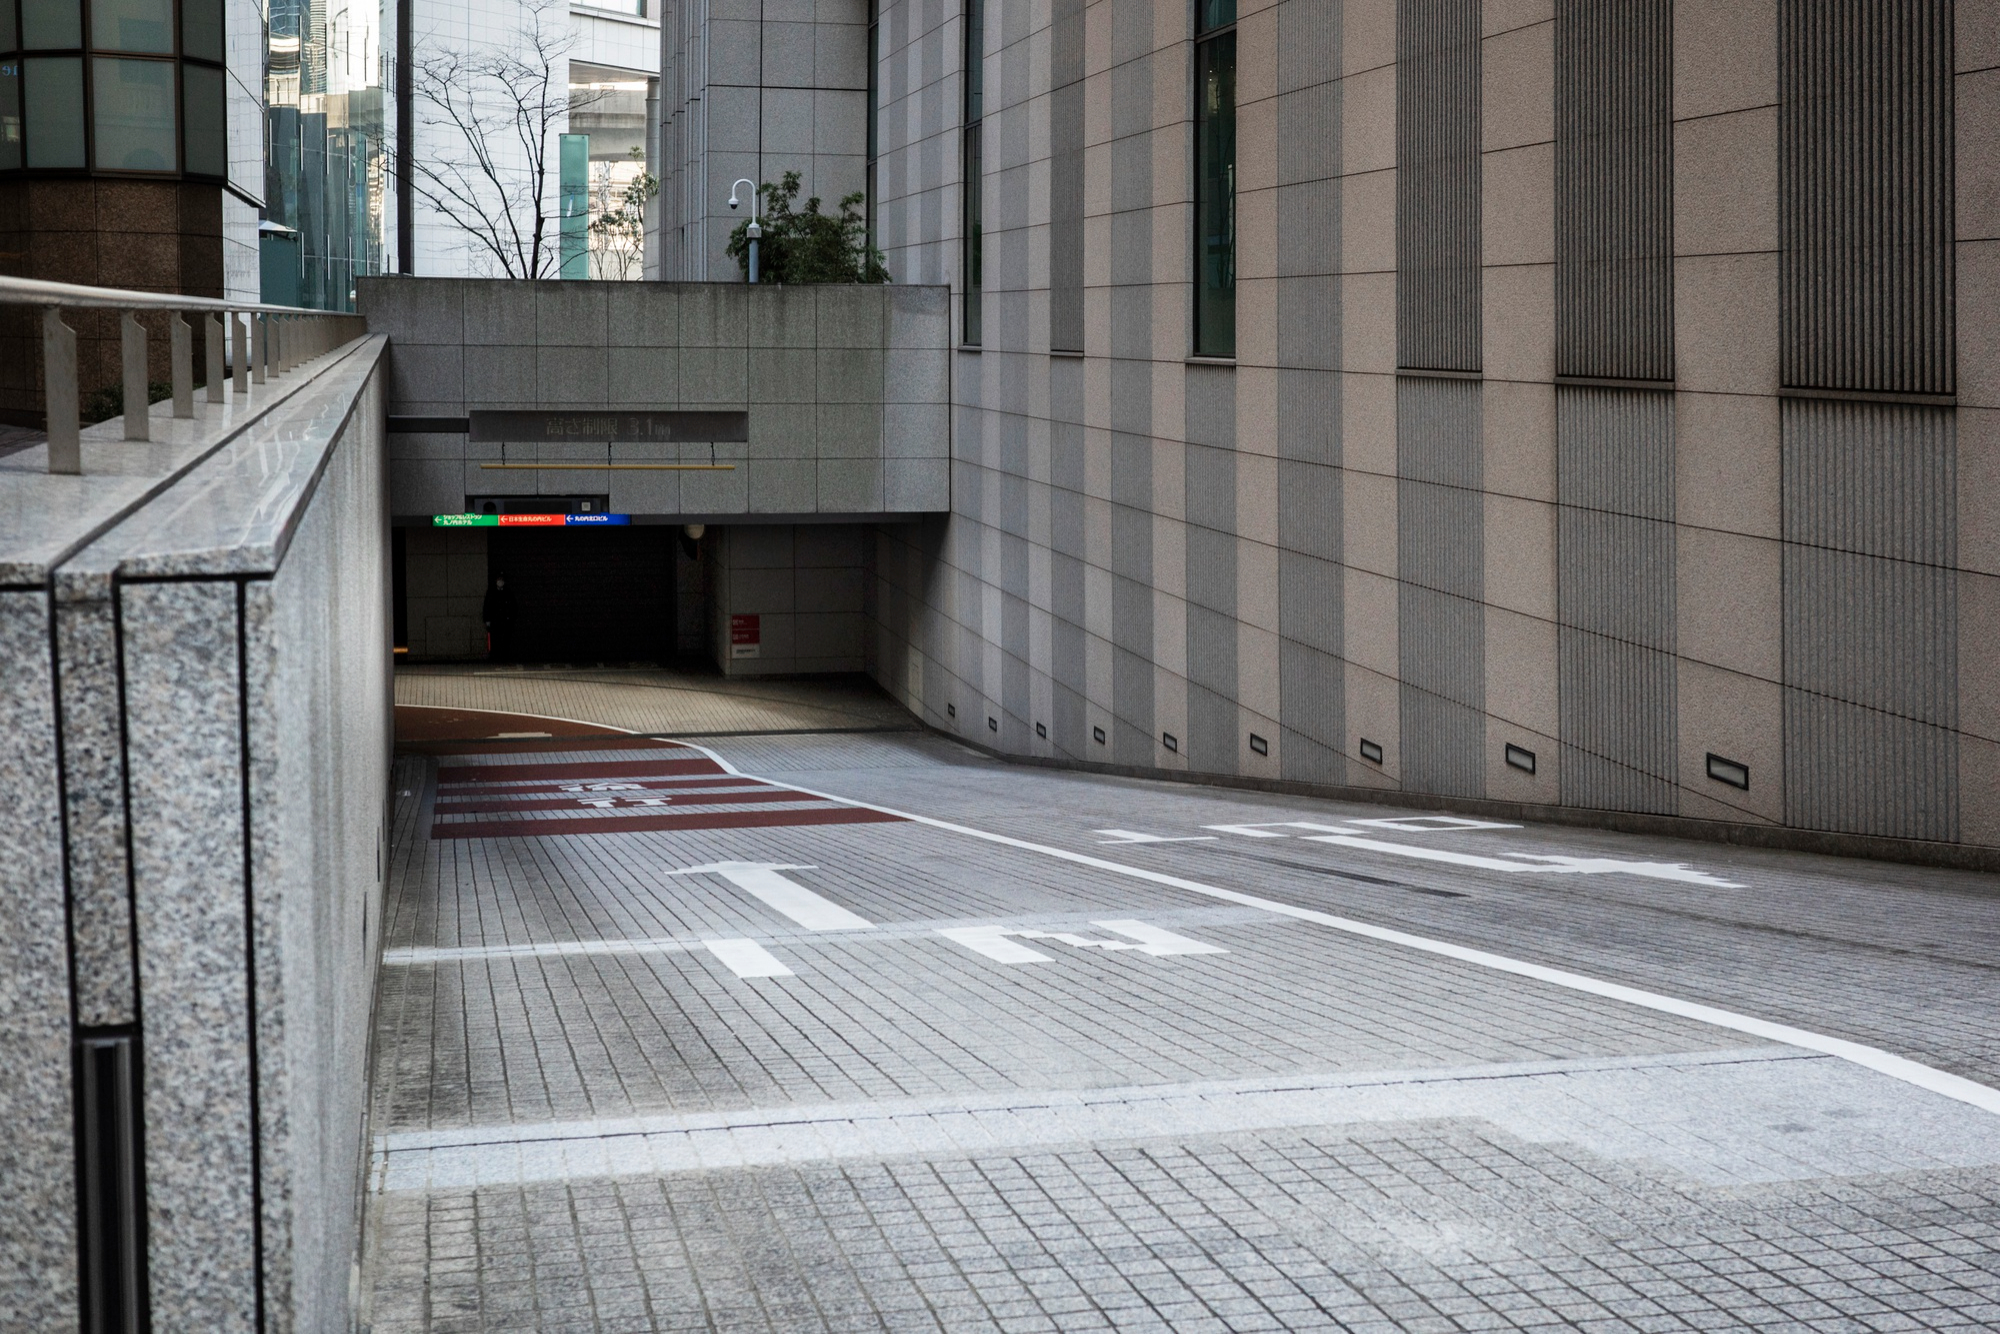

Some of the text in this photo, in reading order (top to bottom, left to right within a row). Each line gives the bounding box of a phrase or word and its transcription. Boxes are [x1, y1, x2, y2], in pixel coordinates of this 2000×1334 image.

[546, 417, 618, 436] 高さ制限
[702, 918, 1231, 978] IN
